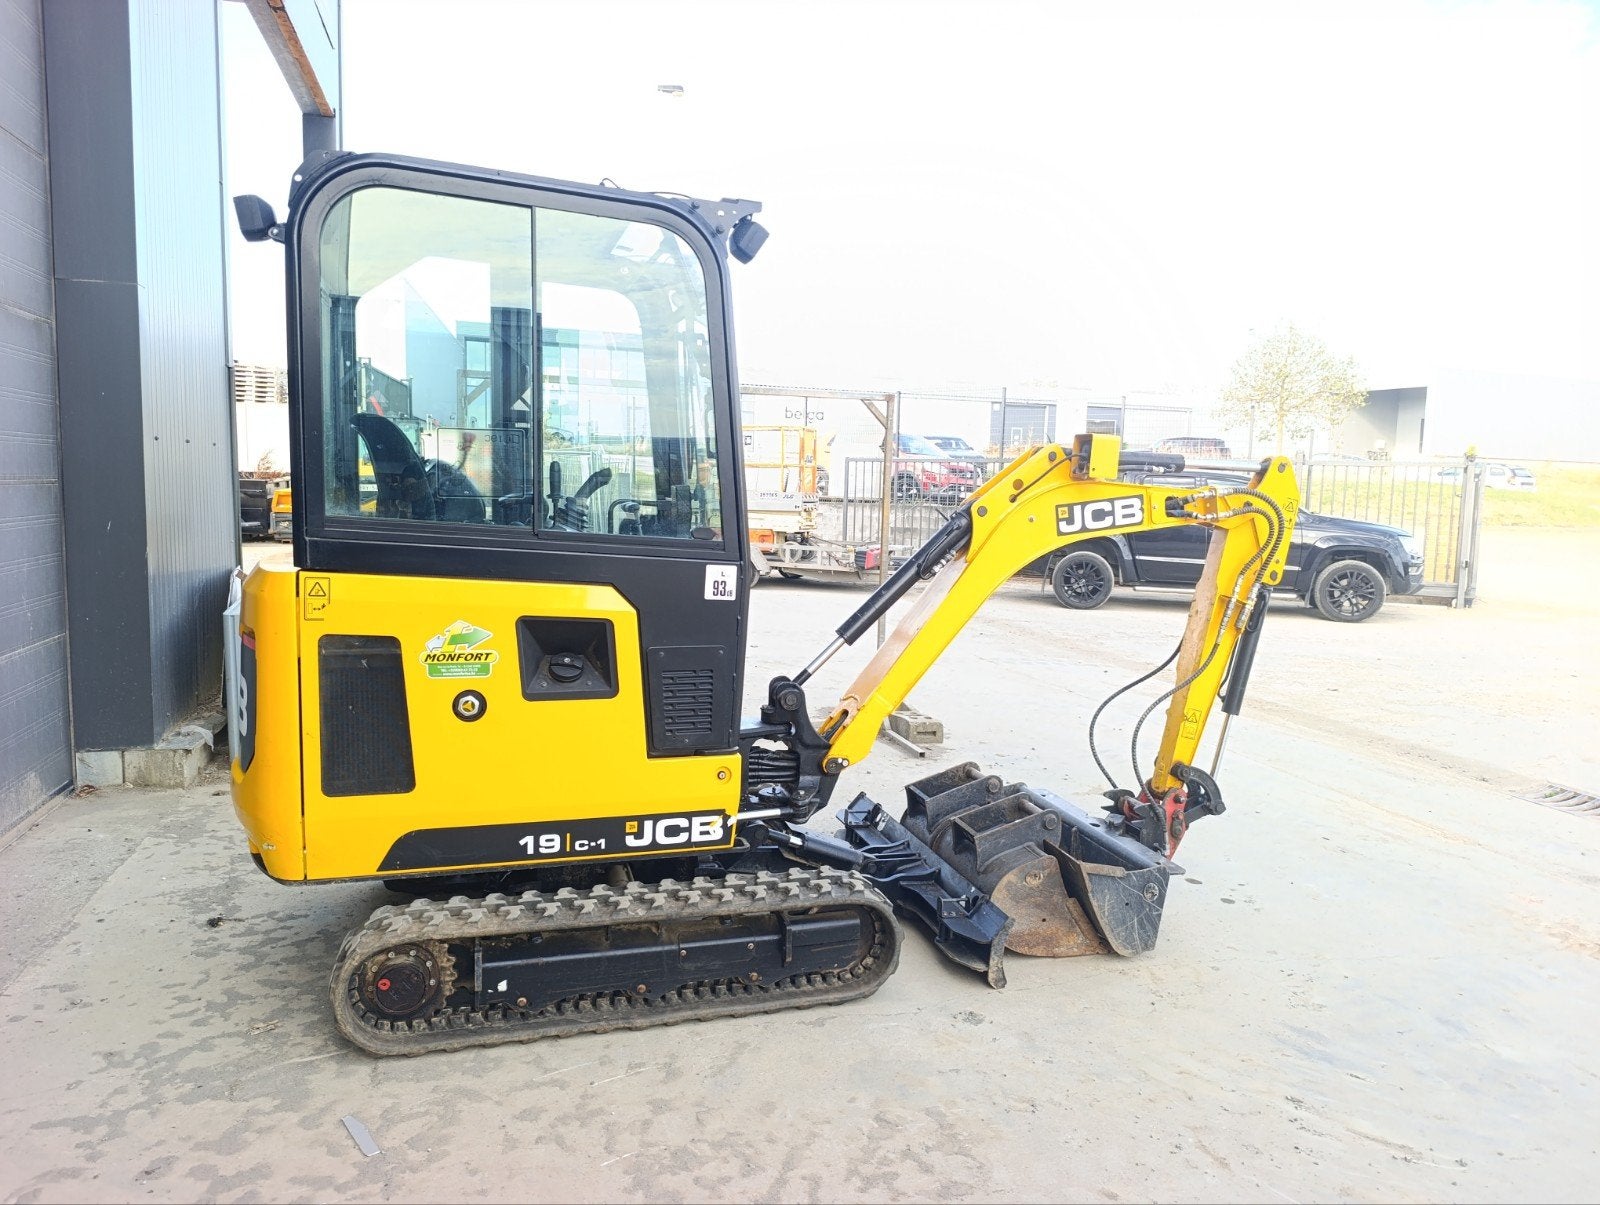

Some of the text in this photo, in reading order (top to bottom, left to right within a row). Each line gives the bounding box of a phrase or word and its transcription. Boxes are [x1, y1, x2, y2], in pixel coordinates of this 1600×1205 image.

[1058, 497, 1143, 533] JCB
[712, 580, 727, 597] 93
[424, 652, 492, 663] MONFORT
[518, 833, 561, 855] 19
[625, 814, 724, 848] JCB
